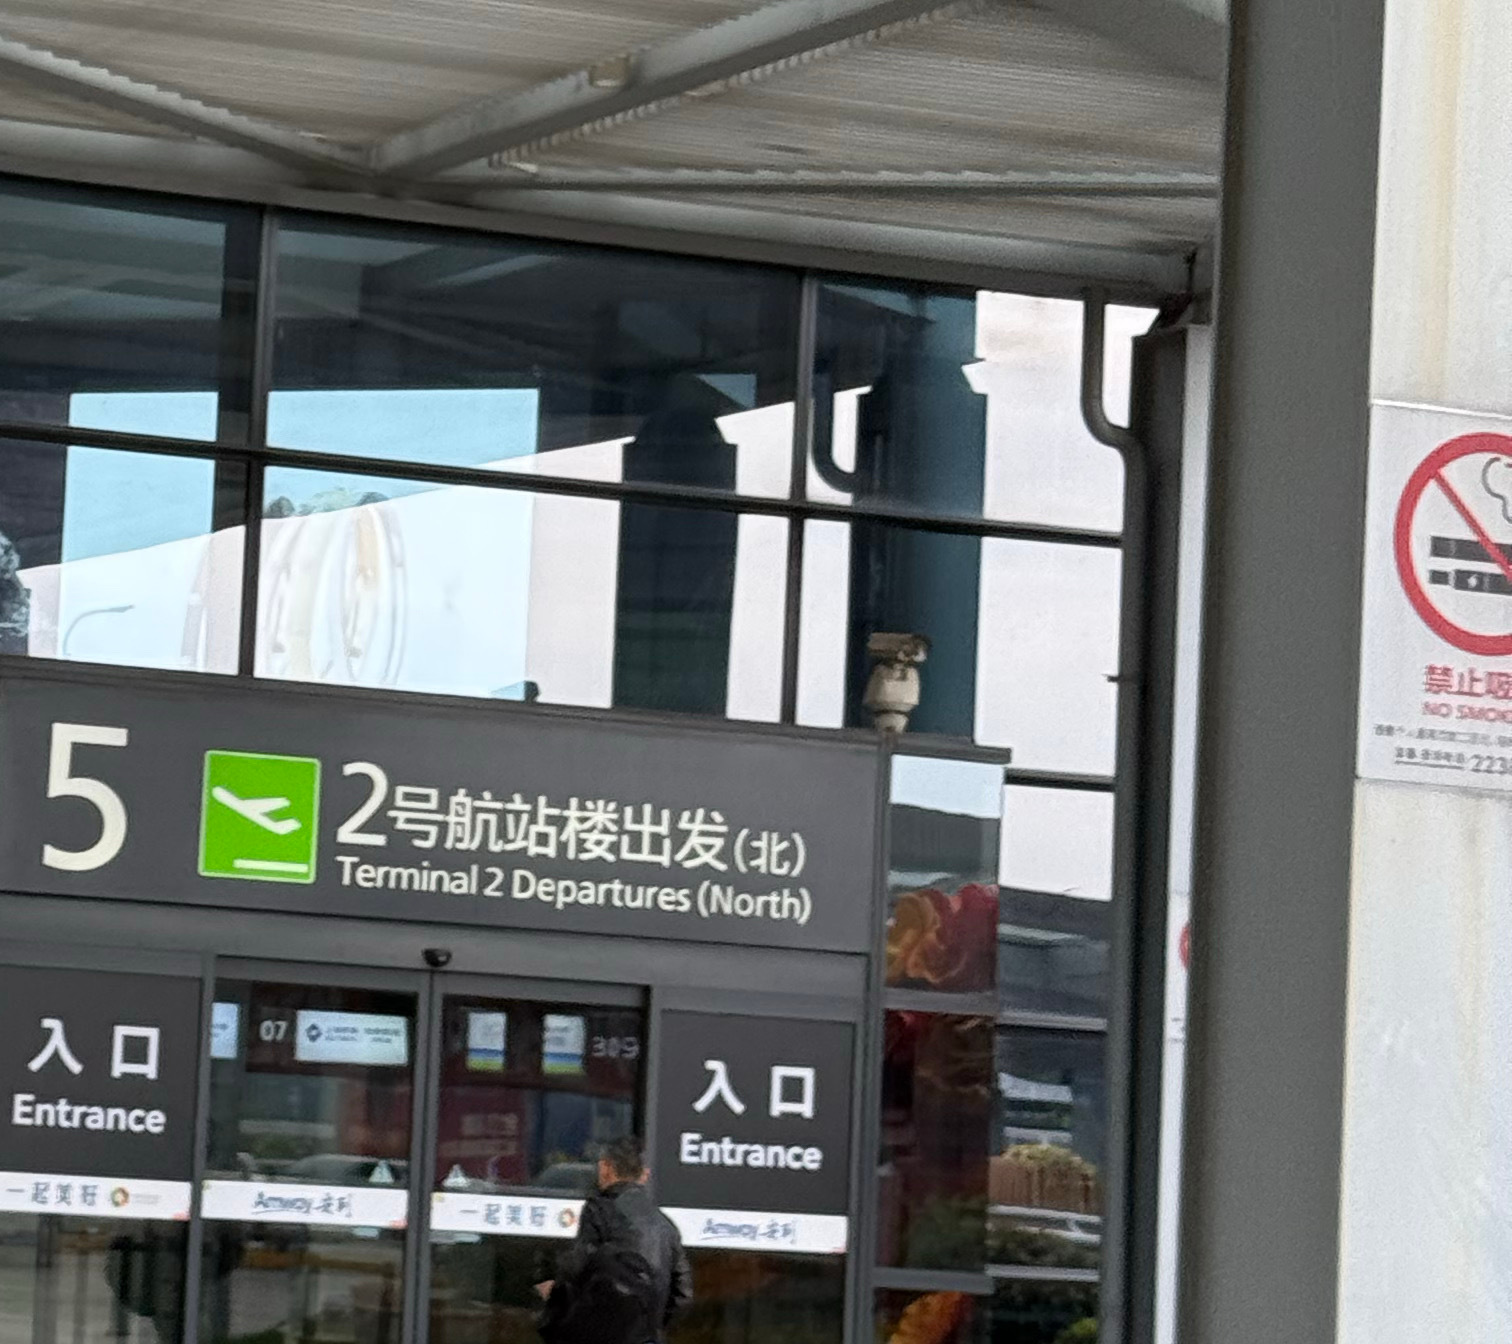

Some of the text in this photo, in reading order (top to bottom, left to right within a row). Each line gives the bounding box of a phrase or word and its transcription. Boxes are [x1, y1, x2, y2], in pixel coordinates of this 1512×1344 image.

[42, 722, 129, 871] 5
[336, 762, 806, 878] 2号航站楼出发(北)
[336, 856, 813, 926] Terminal 2 Departures (North)
[27, 1017, 161, 1081] 入口
[11, 1092, 168, 1134] Entrance
[691, 1059, 816, 1120] 入口
[679, 1132, 824, 1171] Entrance
